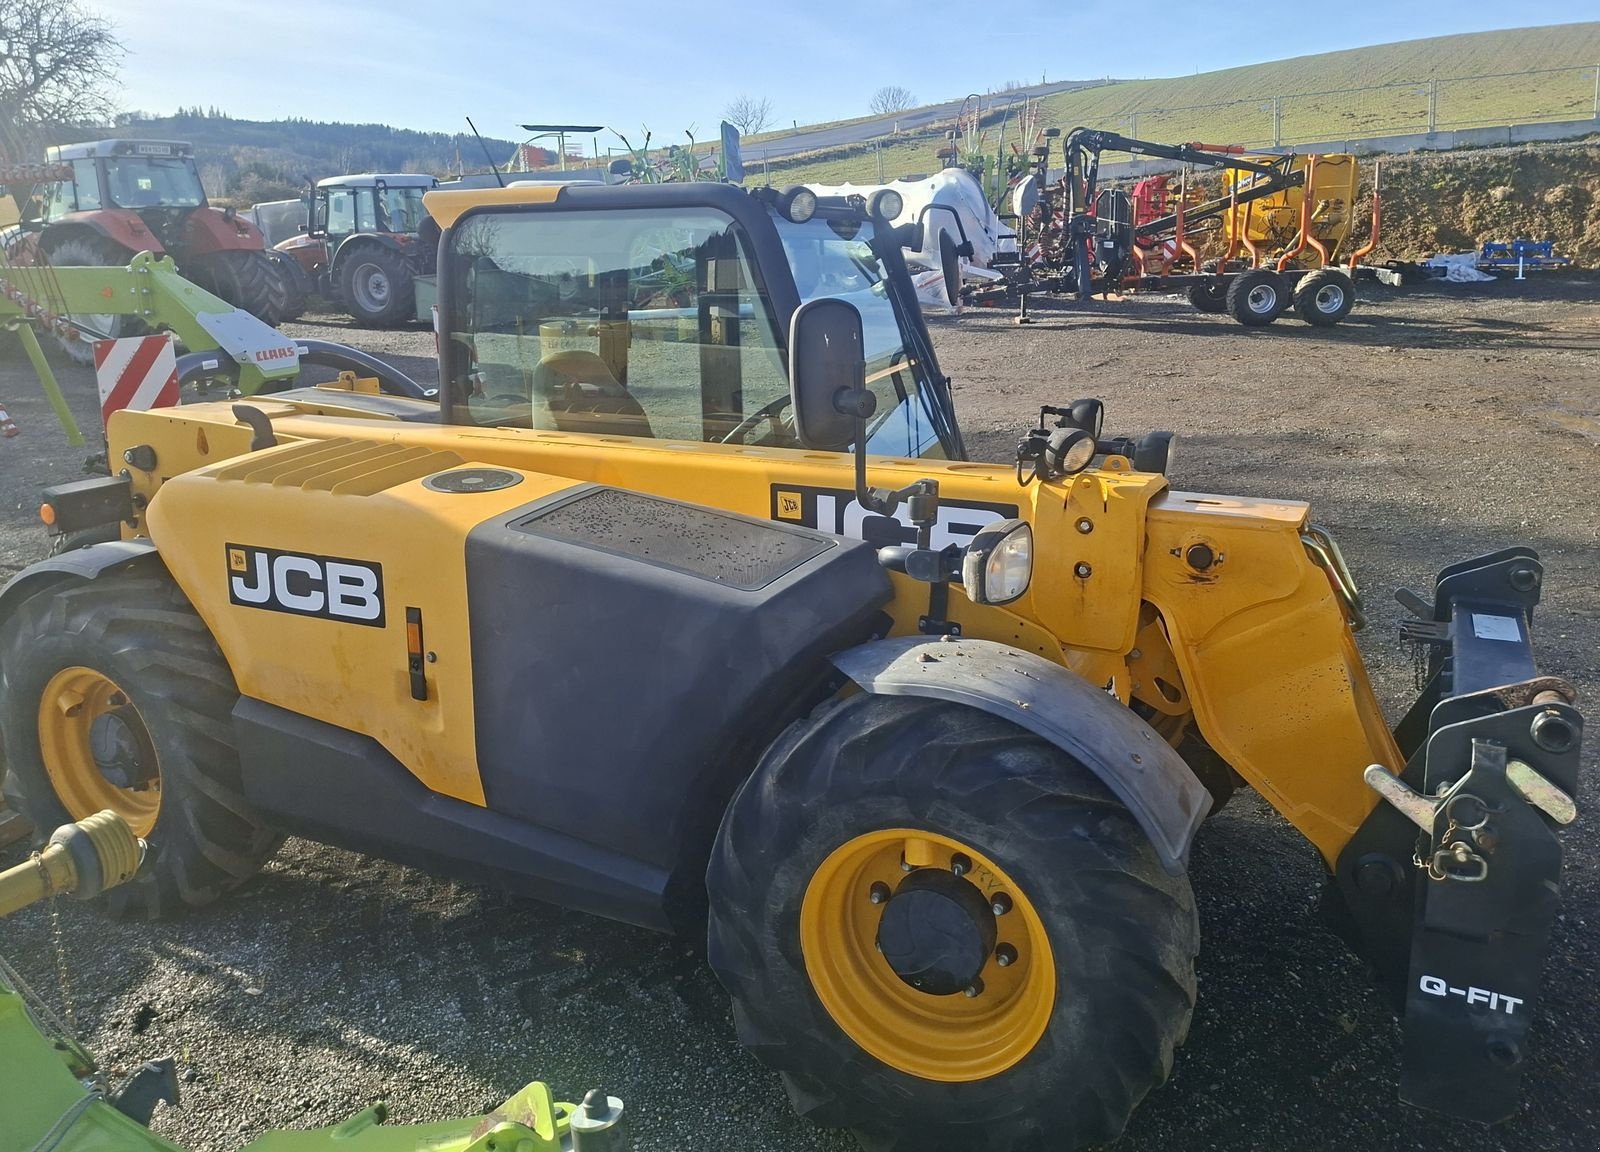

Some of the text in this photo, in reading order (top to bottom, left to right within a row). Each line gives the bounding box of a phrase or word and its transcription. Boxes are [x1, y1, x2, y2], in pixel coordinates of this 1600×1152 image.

[255, 347, 295, 361] CLAAS
[232, 552, 381, 620] JCB
[1420, 975, 1523, 1014] Q-FIT
